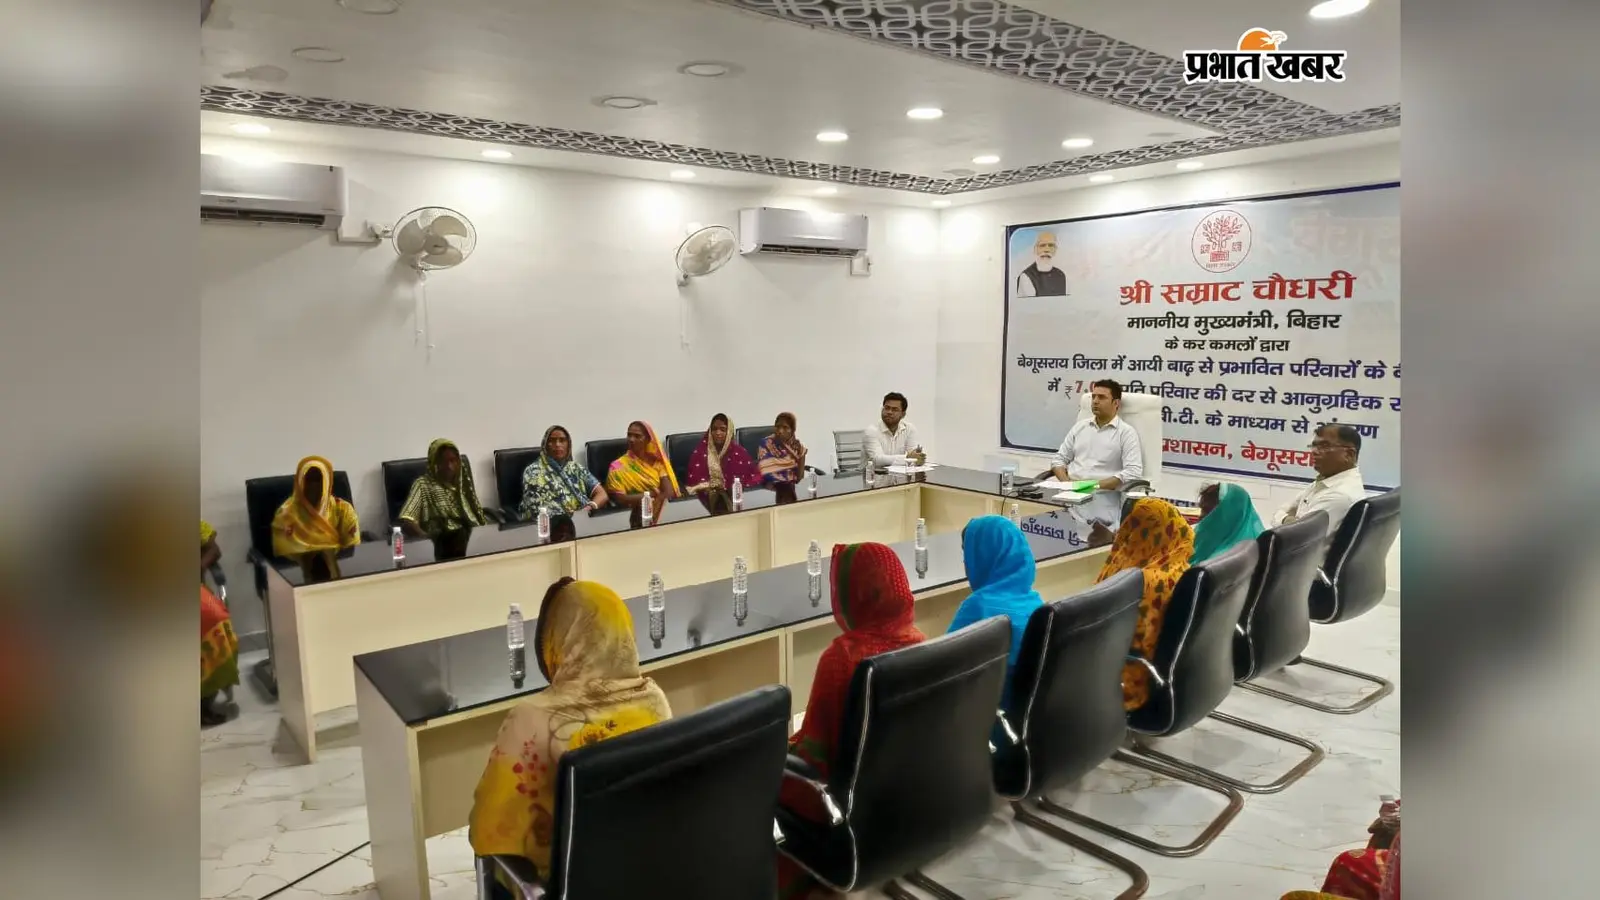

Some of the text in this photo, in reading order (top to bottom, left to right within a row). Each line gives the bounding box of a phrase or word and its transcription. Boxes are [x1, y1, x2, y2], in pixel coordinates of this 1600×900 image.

[1120, 270, 1357, 305] श्री सम्राट चौधरी
[1127, 309, 1342, 335] माननीय मुख्यमंत्री, बिहार
[1164, 336, 1290, 352] के कर कमलों द्वारा
[1072, 353, 1108, 371] जिला
[1111, 355, 1127, 372] में
[1127, 355, 1163, 372] आयी
[1167, 360, 1195, 377] बाढ़
[1198, 356, 1214, 373] से
[1218, 357, 1285, 376] प्रभावित
[1290, 358, 1362, 378] परिवारों
[1364, 360, 1387, 379] के
[1048, 378, 1062, 392] में
[1150, 381, 1201, 400] परिवार
[1203, 383, 1228, 402] की
[1231, 389, 1257, 403] दर
[1259, 386, 1278, 404] से
[1280, 389, 1384, 414] आनुग्रहिक
[1205, 410, 1223, 427] के
[1228, 415, 1286, 432] माध्यम
[1291, 415, 1310, 434] से
[1240, 441, 1316, 471] बेगूसरा
